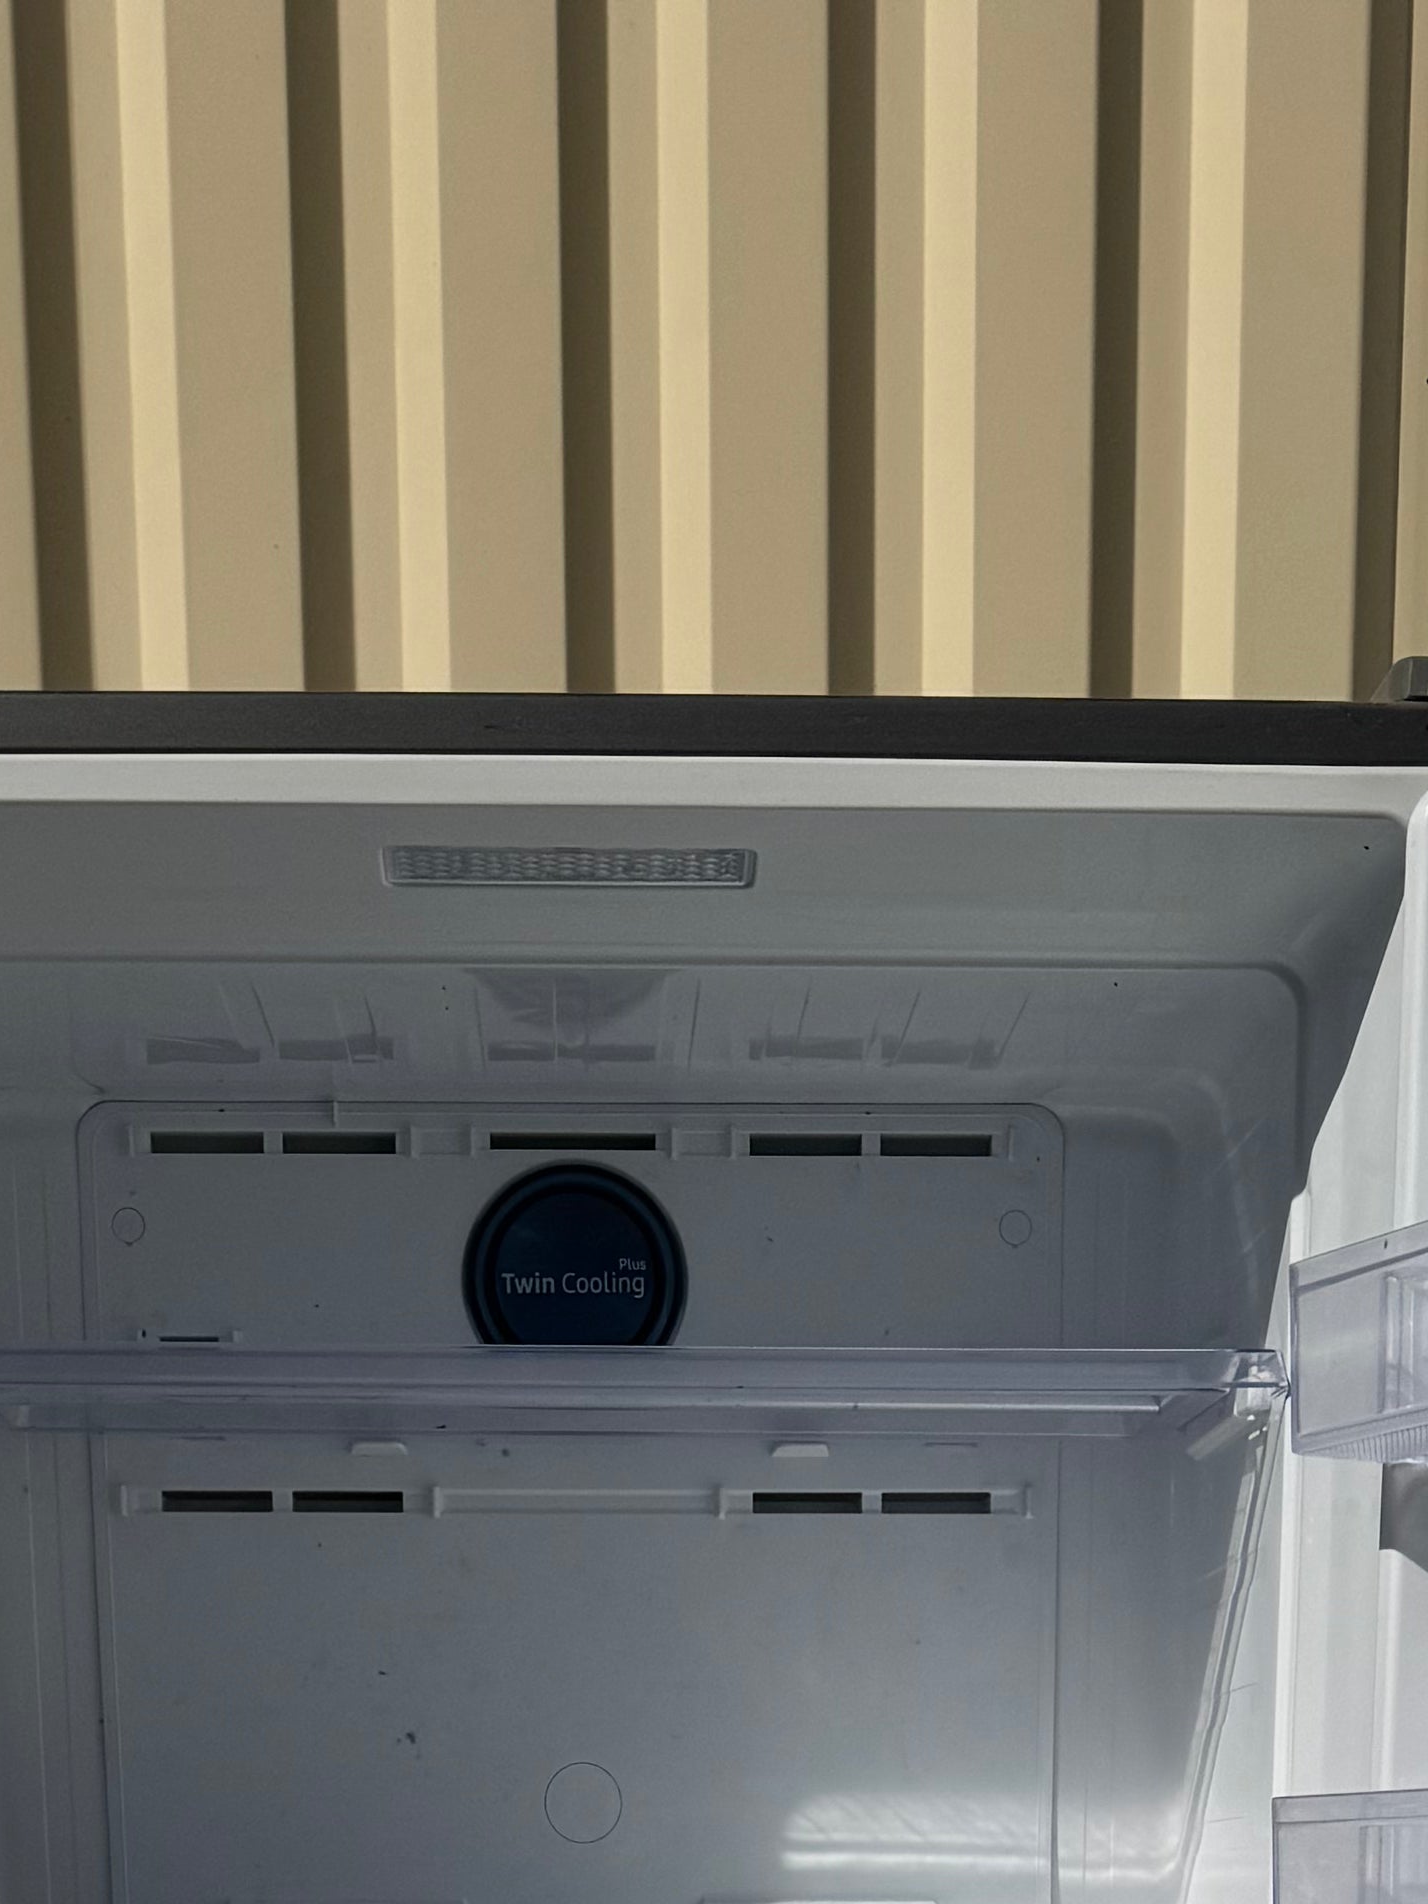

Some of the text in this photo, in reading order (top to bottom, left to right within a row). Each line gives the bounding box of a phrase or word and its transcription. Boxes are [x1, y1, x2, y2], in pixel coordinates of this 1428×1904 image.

[618, 1258, 647, 1271] Plus
[501, 1271, 645, 1299] Twin Cooling
